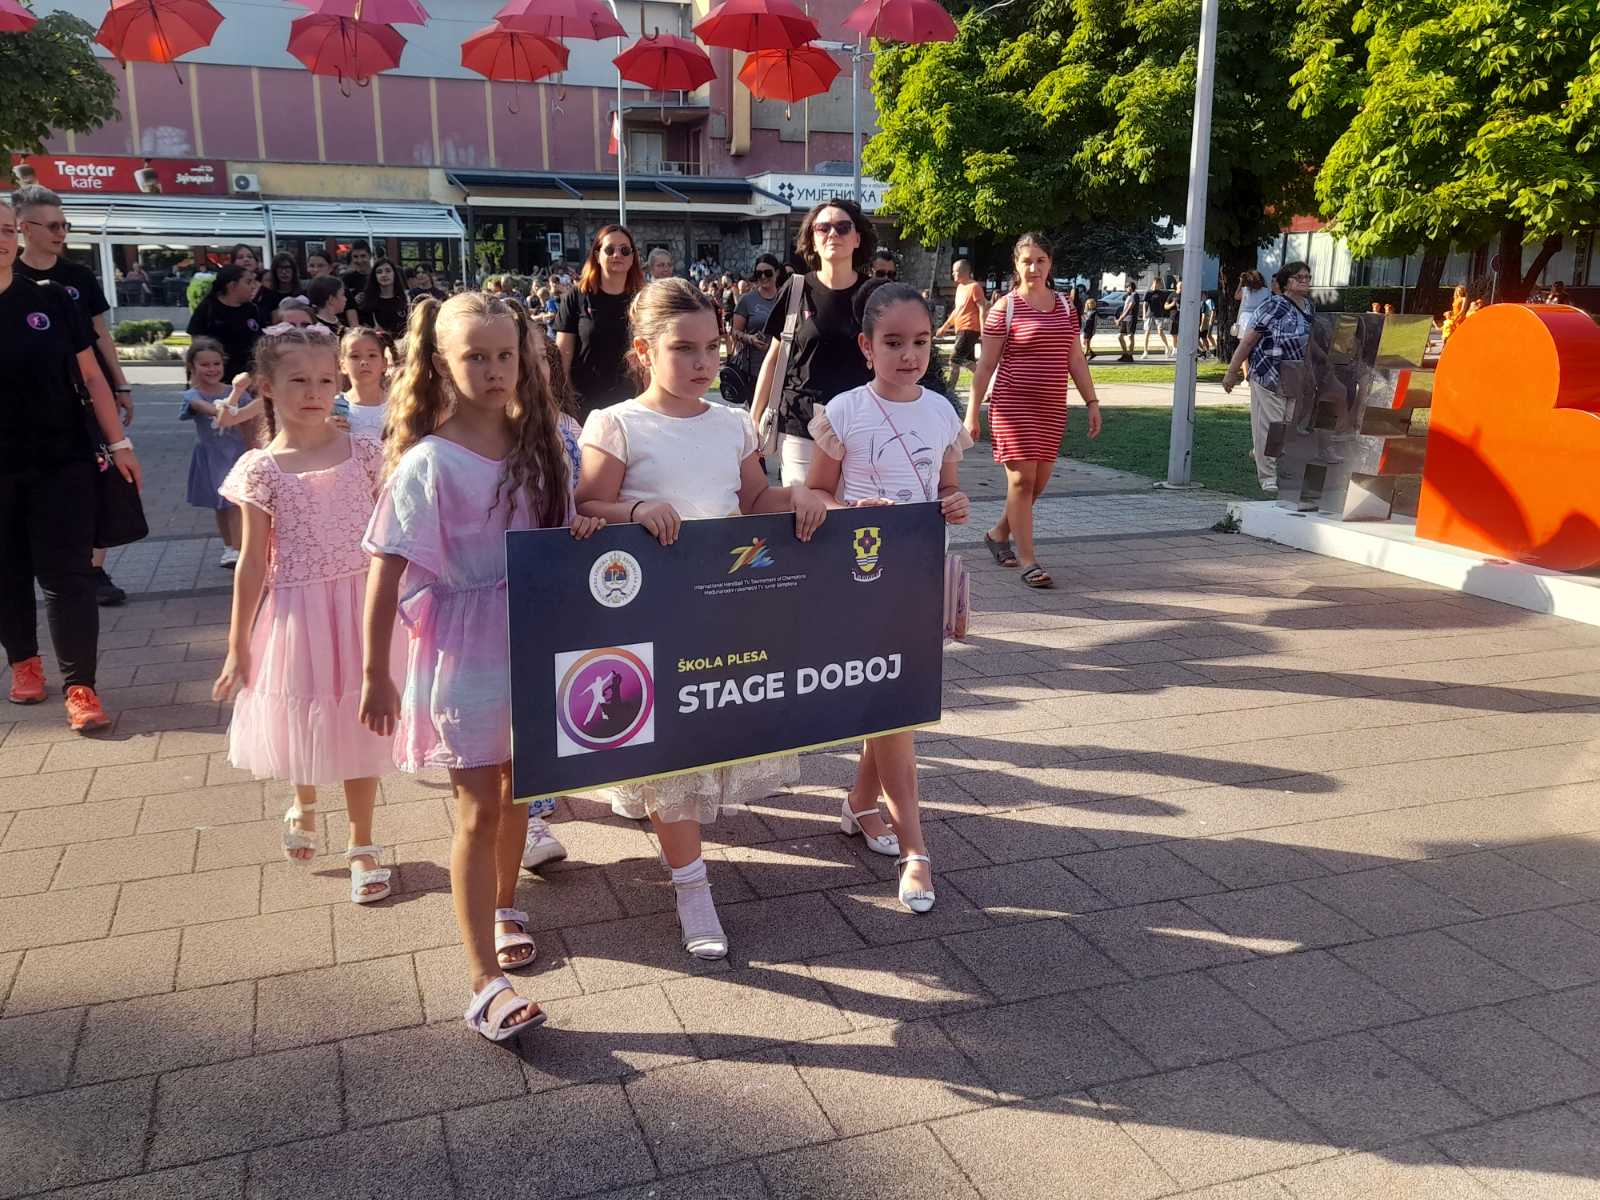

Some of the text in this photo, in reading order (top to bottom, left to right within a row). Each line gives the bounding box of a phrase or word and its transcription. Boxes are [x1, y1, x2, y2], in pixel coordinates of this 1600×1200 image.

[54, 160, 116, 177] Teatar
[70, 175, 103, 189] kafe
[677, 650, 769, 673] ŠKOLA PLESA
[678, 653, 902, 714] STAGE DOBOJ
